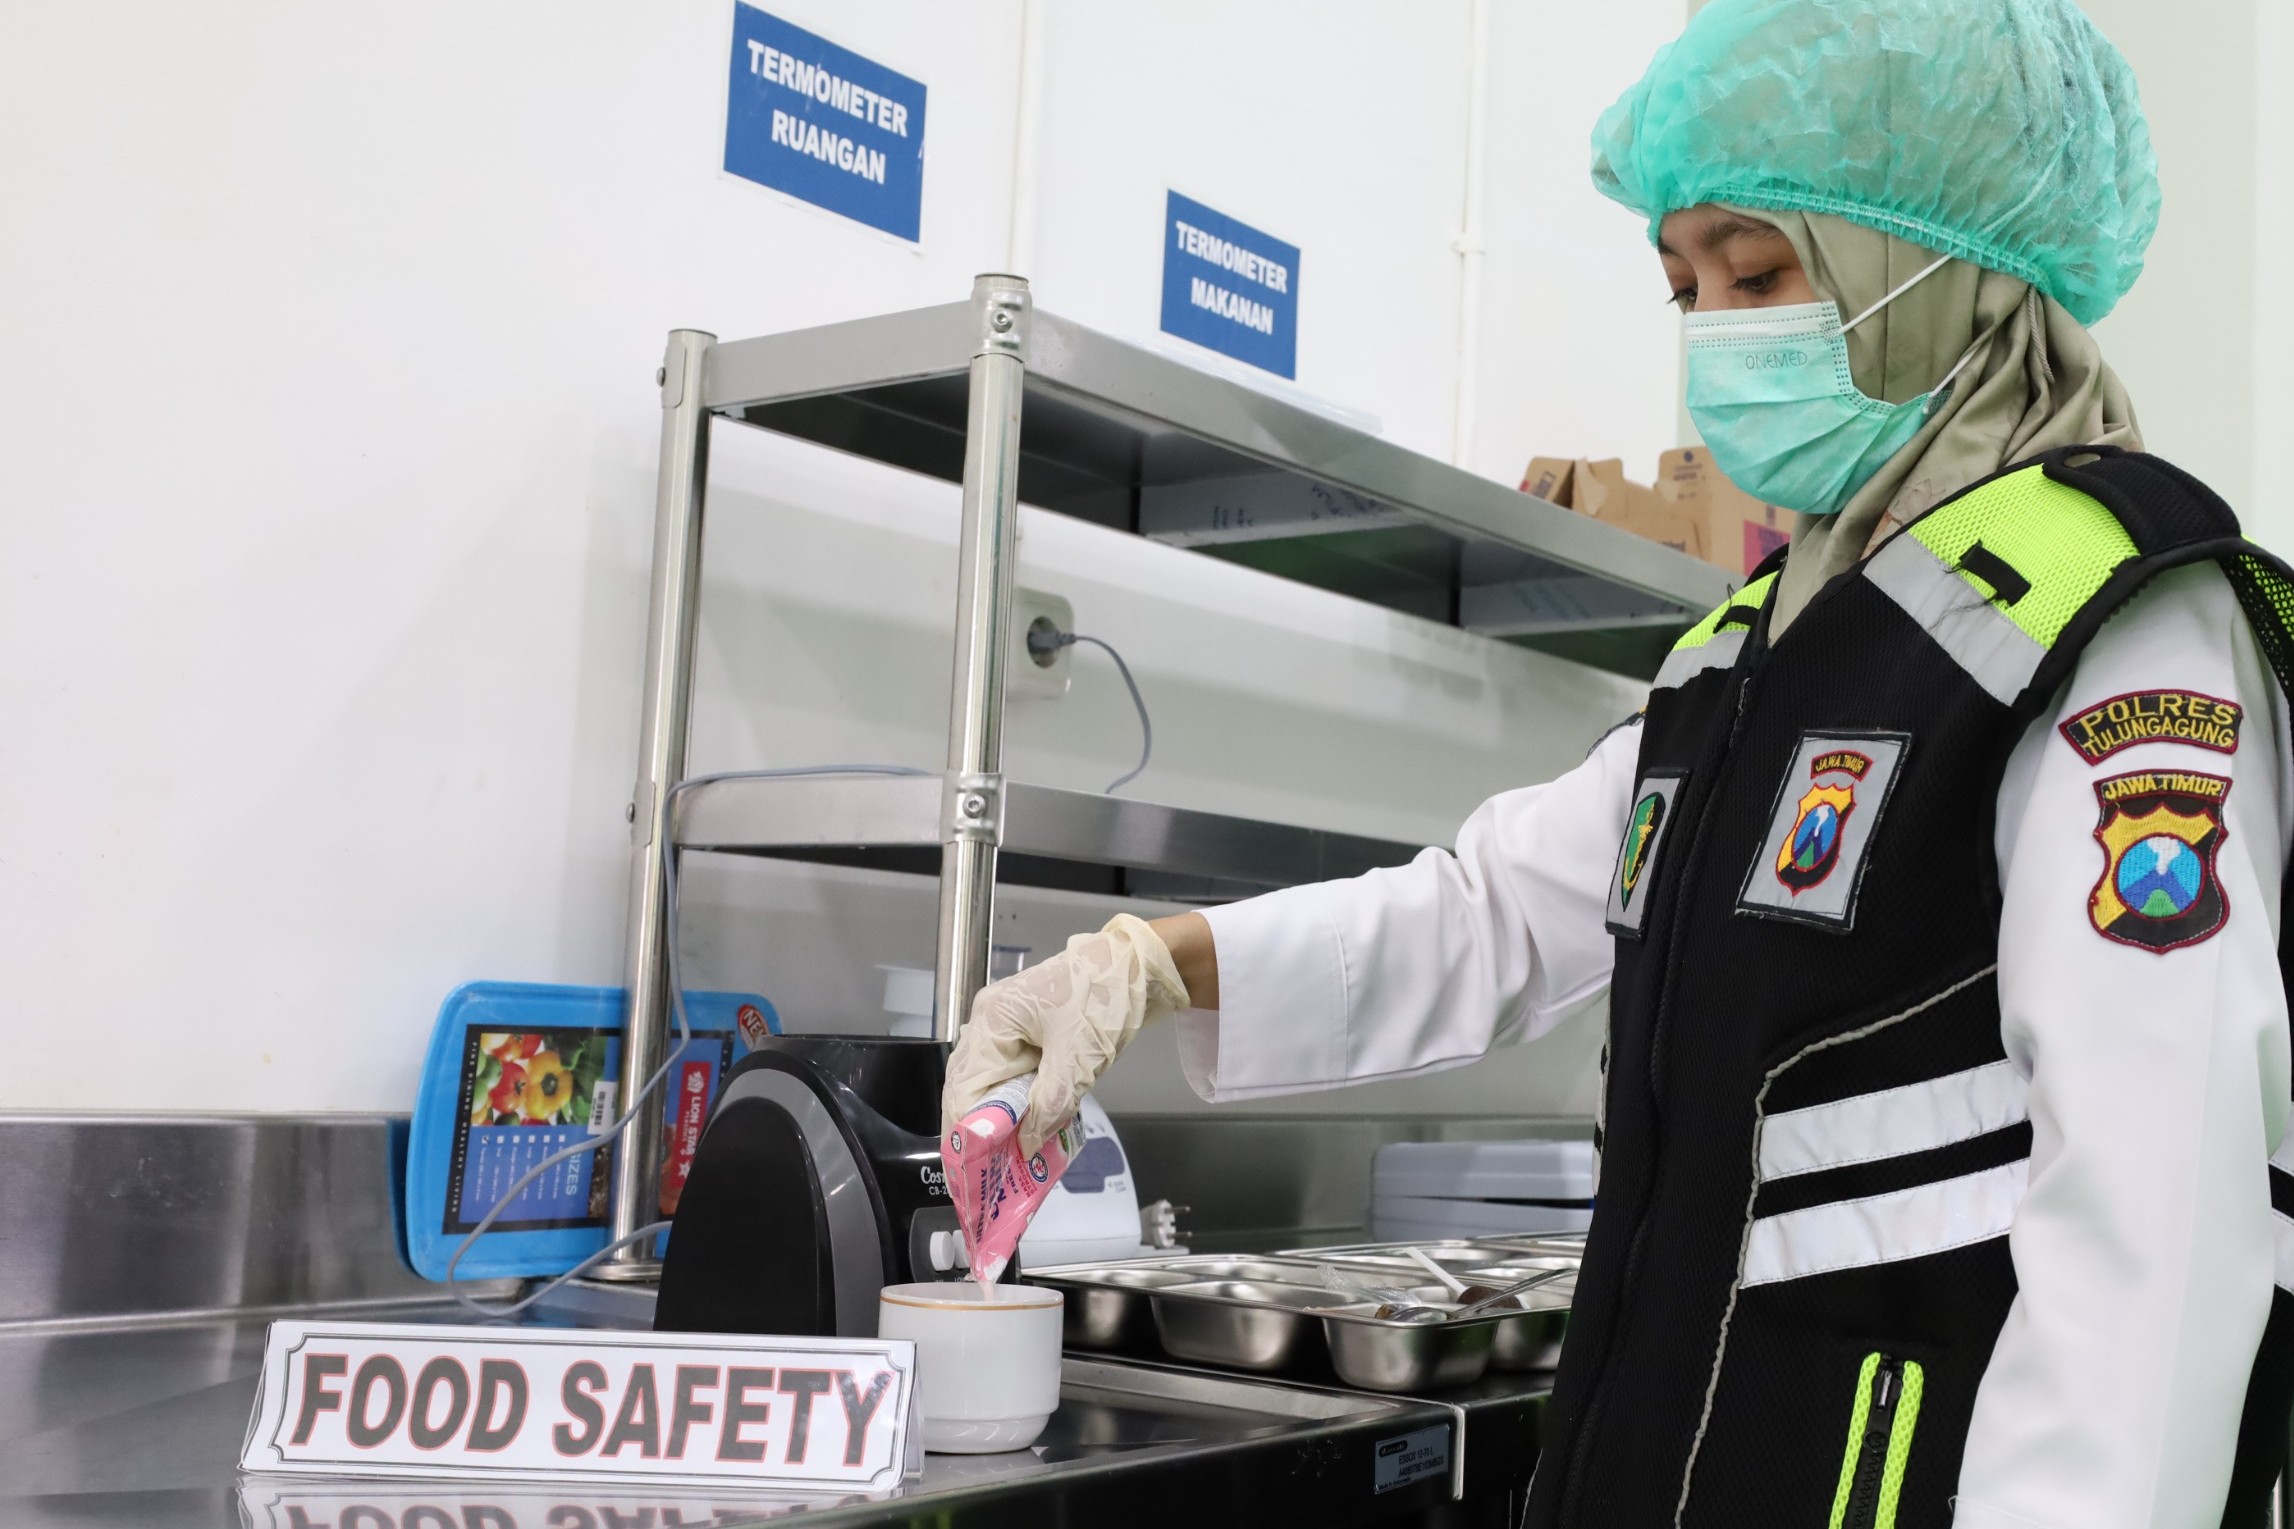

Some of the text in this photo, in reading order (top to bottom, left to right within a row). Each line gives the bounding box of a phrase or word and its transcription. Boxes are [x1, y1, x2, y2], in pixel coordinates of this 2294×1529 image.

[747, 39, 907, 138] TERMOMETER
[772, 109, 886, 185] RUANGAN
[1176, 220, 1288, 294] TERMOMETER
[1191, 277, 1274, 336] MAKANAN
[1745, 351, 1808, 370] ONEMED
[2079, 693, 2239, 738] POLRES
[2083, 716, 2235, 757] TULUNGAGUNG
[2104, 773, 2223, 800] JAWA TIMUR
[685, 1096, 702, 1156] LION STAR
[289, 1352, 897, 1468] FOOD SAFETY
